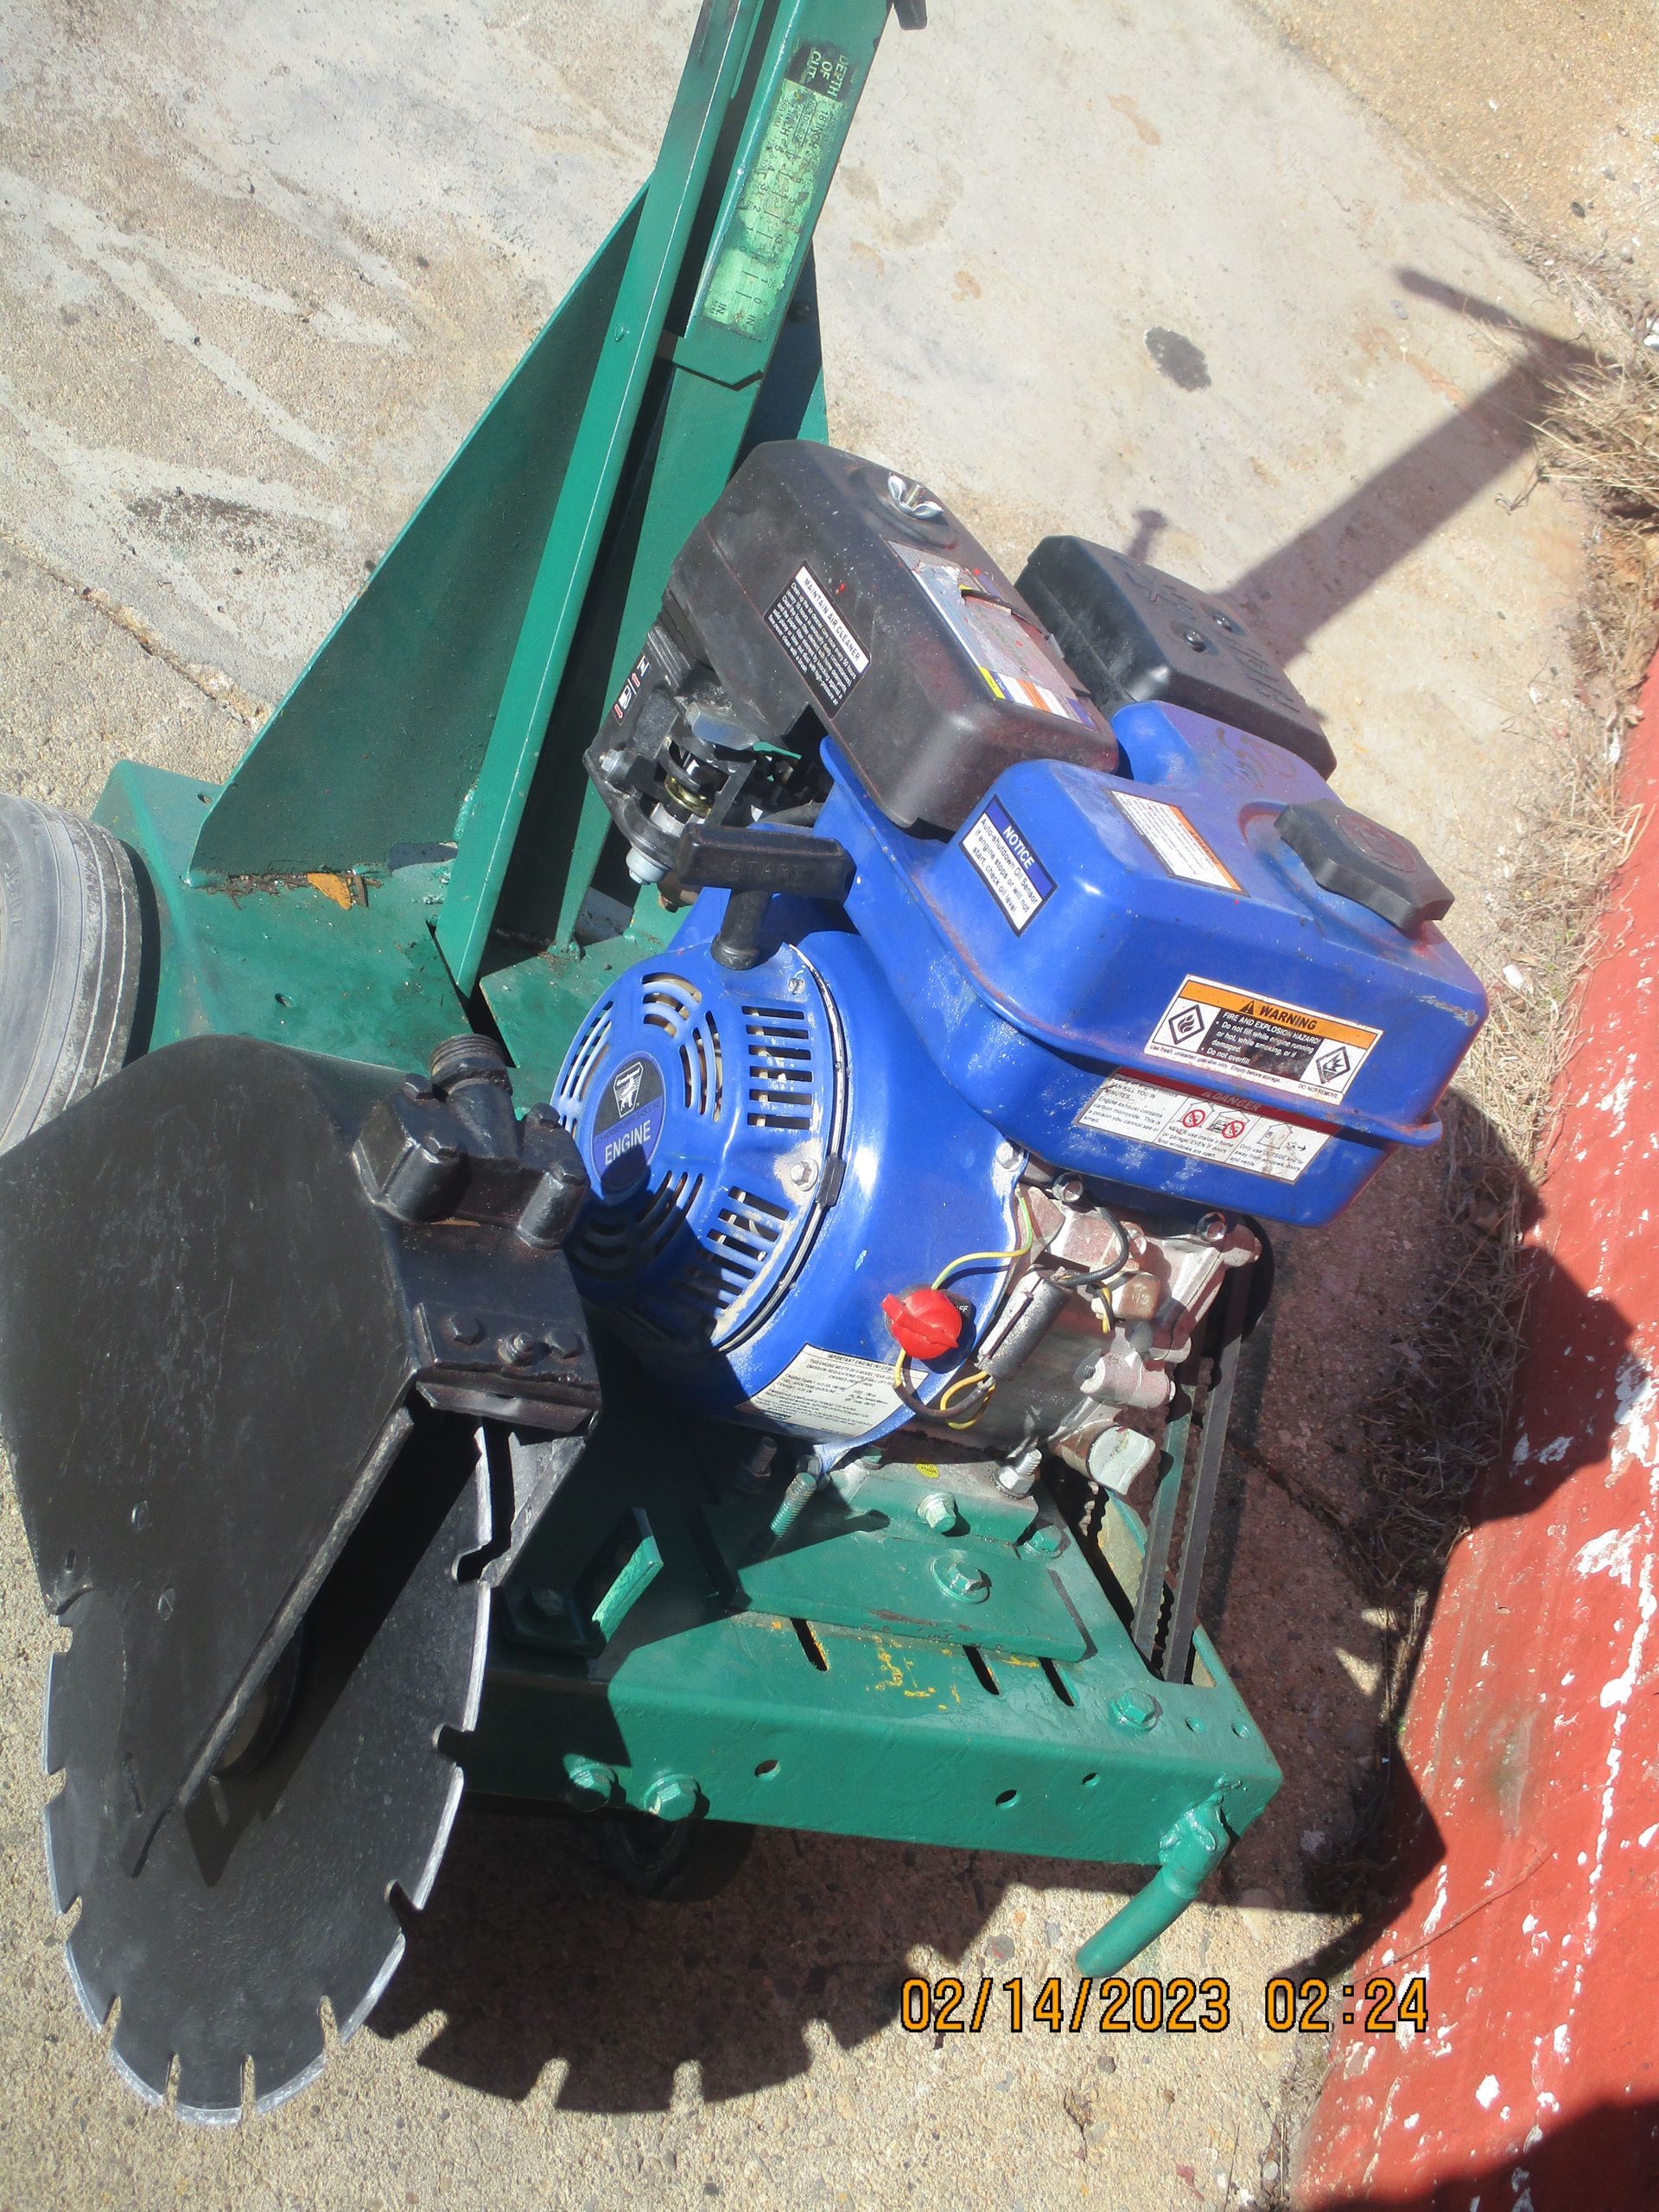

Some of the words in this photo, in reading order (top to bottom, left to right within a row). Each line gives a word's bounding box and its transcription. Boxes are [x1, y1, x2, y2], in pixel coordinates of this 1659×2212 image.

[804, 50, 822, 78] CUT
[817, 60, 833, 79] OF
[825, 54, 850, 98] DEPTH
[817, 109, 828, 122] 18
[715, 302, 727, 318] IN.
[799, 607, 808, 620] hours
[804, 577, 828, 613] MAINTAIN
[827, 612, 837, 627] AIR
[836, 626, 859, 660] CLEANER
[834, 647, 843, 662] every
[846, 664, 856, 679] hours
[974, 828, 981, 837] If
[977, 835, 995, 861] engine
[1003, 824, 1033, 869] NOTICE
[981, 818, 1015, 868] Auto-shutdown
[1014, 866, 1023, 880] Oil
[1020, 878, 1039, 904] Sensor
[994, 858, 1007, 880] stops
[985, 863, 1000, 886] check
[998, 884, 1007, 896] oil
[1007, 878, 1014, 887] or
[1012, 886, 1022, 899] will
[1020, 899, 1029, 912] not
[1258, 1005, 1319, 1031] WARNING
[1220, 1021, 1232, 1030] Do
[1230, 1025, 1243, 1033] not
[1242, 1027, 1253, 1036] fill
[1250, 1030, 1270, 1041] while
[1268, 1035, 1292, 1048] engine
[1289, 1041, 1315, 1054] running
[1222, 1011, 1240, 1021] FIRE
[1237, 1016, 1255, 1026] AND
[1253, 1020, 1294, 1037] EXPLOSION
[1291, 1032, 1321, 1045] HAZARD!
[1210, 1039, 1243, 1053] damaged.
[1223, 1032, 1238, 1042] hot,
[1236, 1035, 1255, 1046] while
[1252, 1040, 1284, 1056] smoking,
[1173, 1050, 1197, 1060] unleaded
[1229, 1065, 1247, 1074] Empty
[1245, 1069, 1262, 1077] before
[1215, 1050, 1229, 1058] not
[1227, 1053, 1252, 1065] overfill.
[1091, 1102, 1114, 1111] carbon
[1096, 1096, 1119, 1106] Engine
[1116, 1101, 1141, 1111] exhaust
[1139, 1108, 1164, 1118] contains
[1211, 1091, 1260, 1111] DANGER
[1090, 1110, 1113, 1121] poison
[1122, 1118, 1144, 1128] cannot
[605, 1119, 652, 1166] ENGINE
[1166, 1125, 1188, 1135] NEVER
[1198, 1134, 1216, 1142] inside
[1189, 1139, 1206, 1147] EVEN
[1167, 1141, 1194, 1151] windows
[1232, 1149, 1250, 1158] away
[1237, 1143, 1255, 1152] Only
[1262, 1149, 1287, 1160] OUTSIDE
[825, 1353, 855, 1363] IMPORTANT
